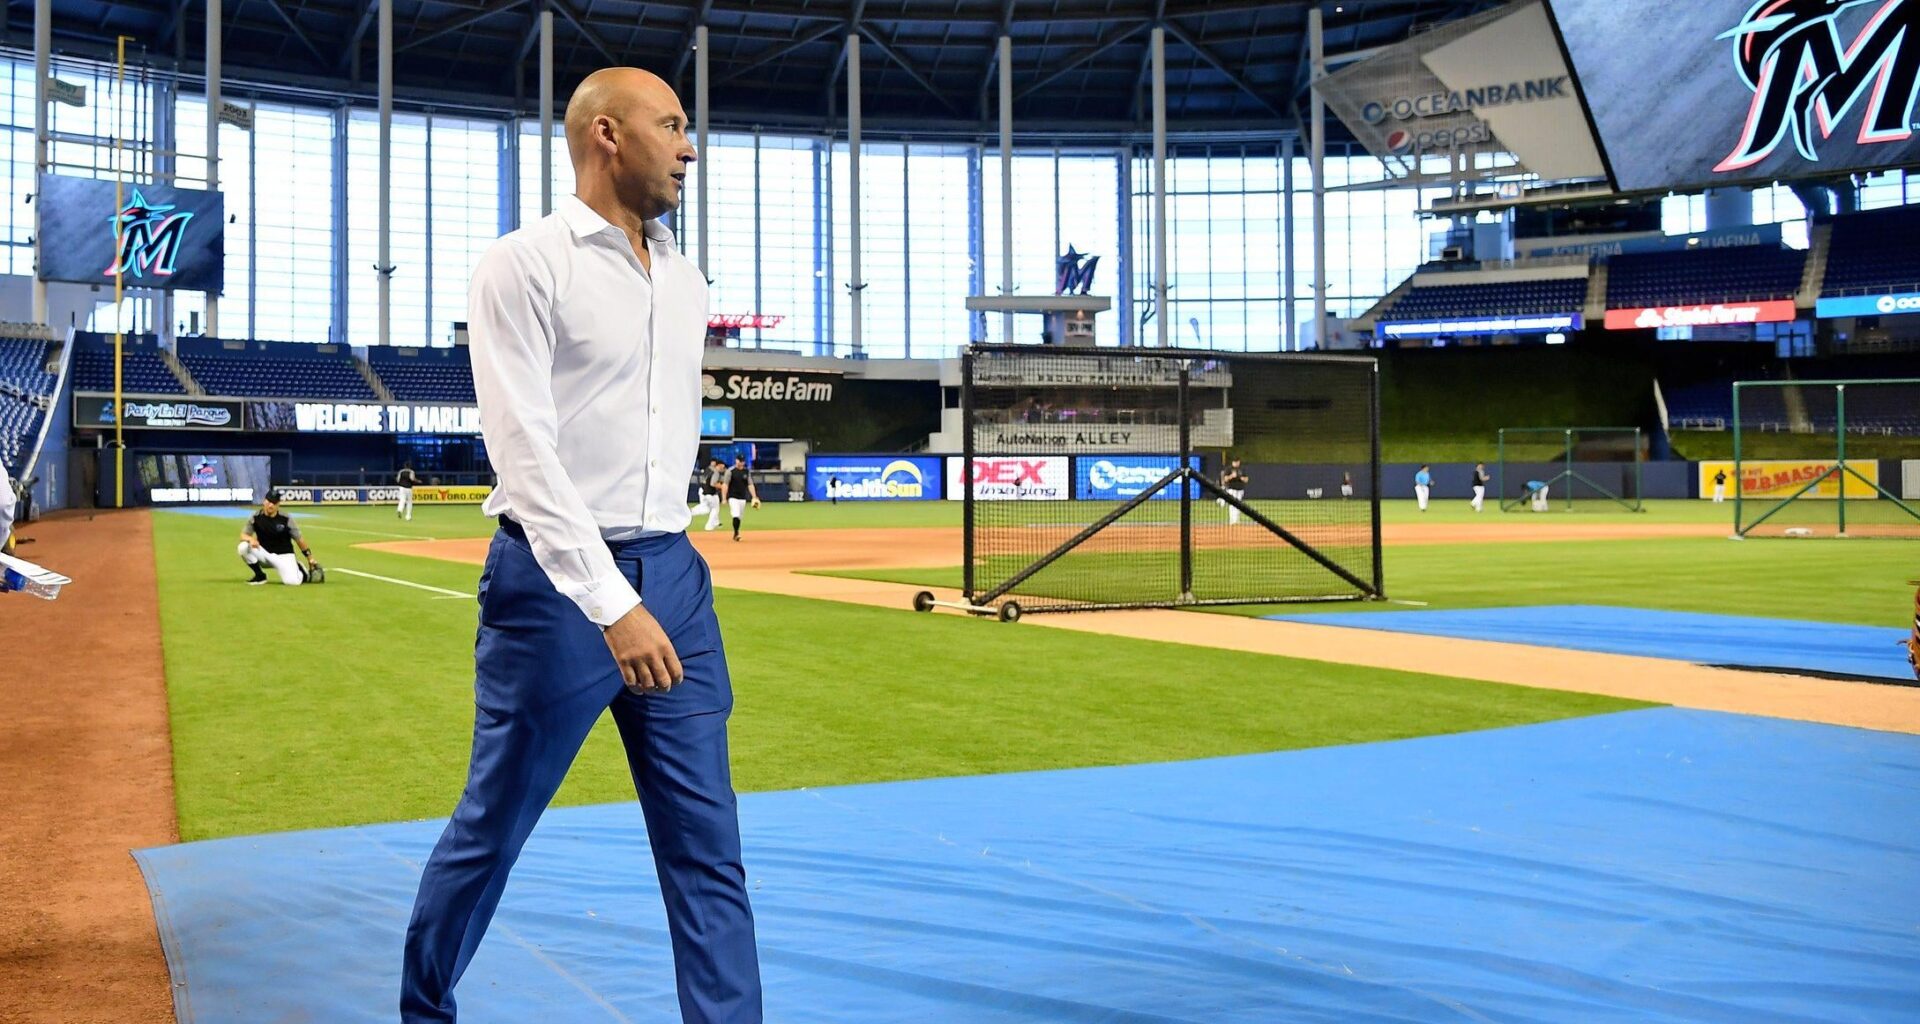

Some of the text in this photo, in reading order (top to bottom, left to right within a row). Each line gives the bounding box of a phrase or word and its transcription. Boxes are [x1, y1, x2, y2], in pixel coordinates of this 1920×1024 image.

[1391, 76, 1569, 120] OCEANBANK
[1415, 119, 1490, 149] pepsi
[124, 403, 159, 421] Party
[187, 404, 231, 425] Parque
[296, 403, 482, 433] WELCOME TO MARLIN
[1075, 432, 1132, 444] ALLEY
[960, 460, 1047, 484] DEX
